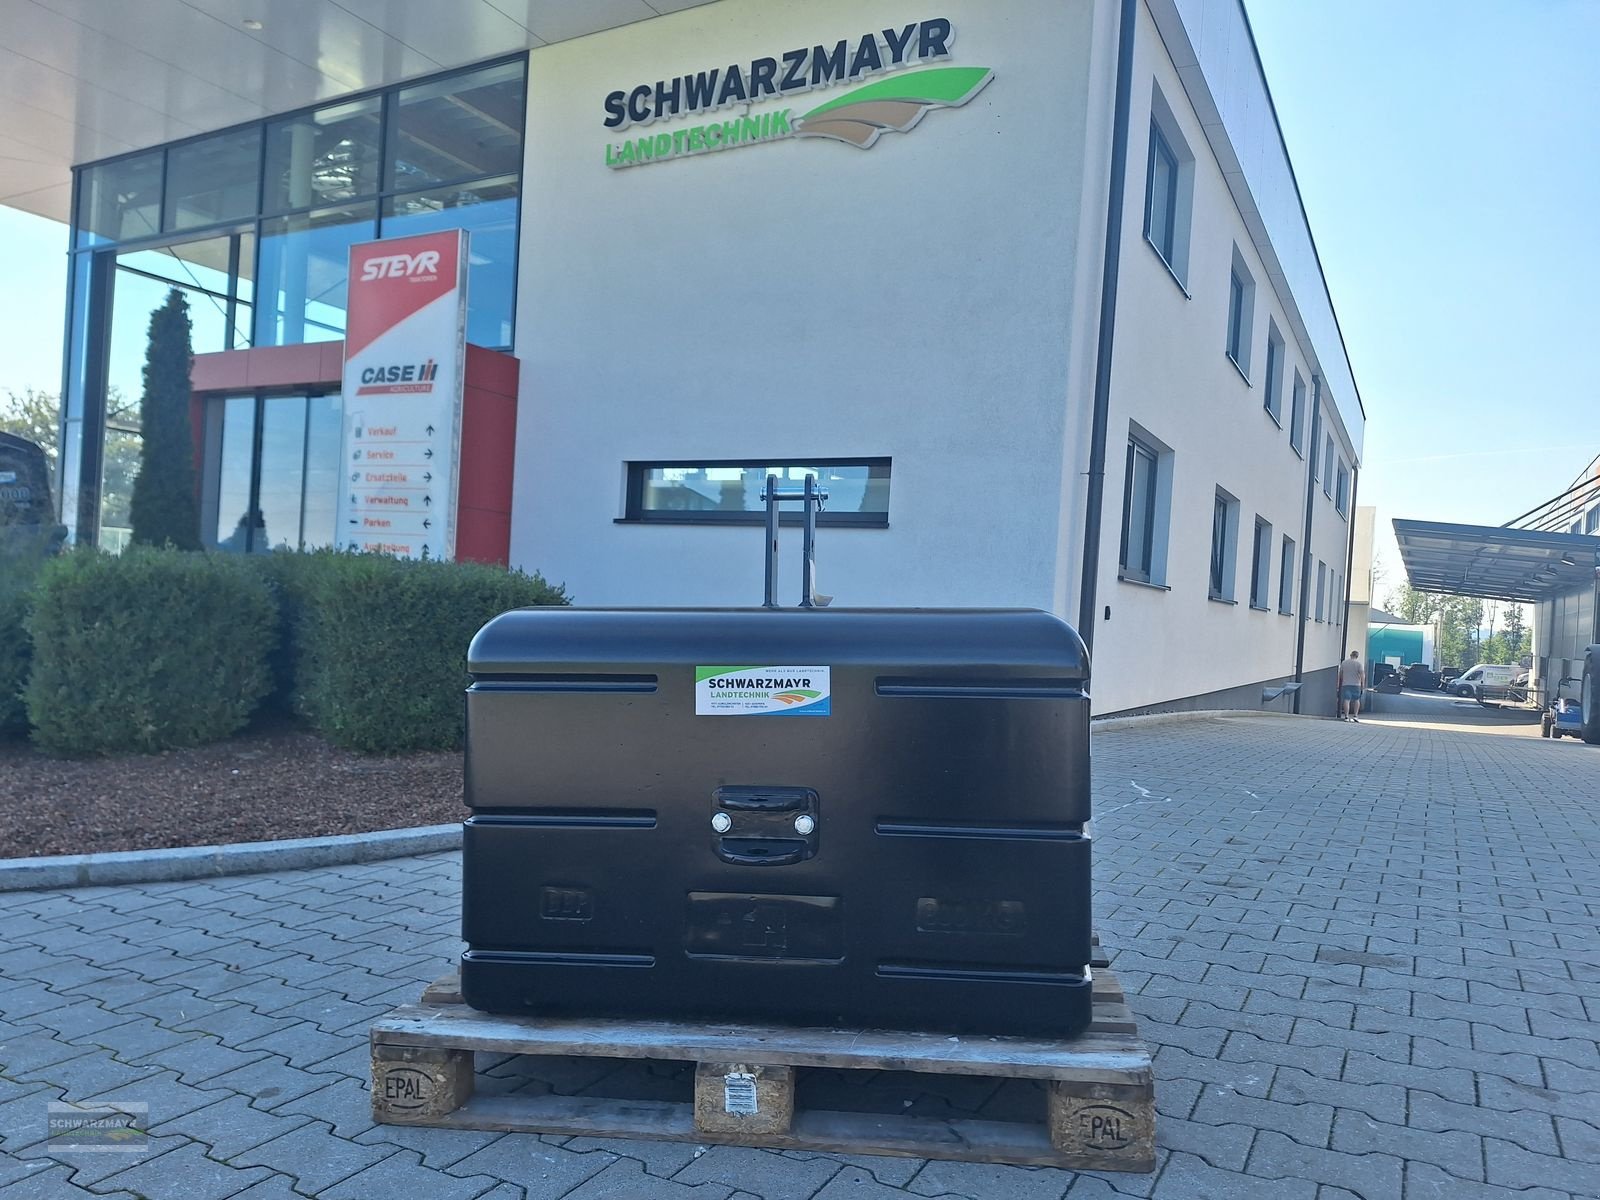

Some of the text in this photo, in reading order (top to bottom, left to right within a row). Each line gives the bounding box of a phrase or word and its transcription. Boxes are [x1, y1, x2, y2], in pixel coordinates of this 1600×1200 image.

[603, 17, 952, 128] SCHWARZMAYR
[606, 109, 791, 167] LANDTECHNIK
[360, 250, 440, 281] STEYR
[361, 365, 415, 384] CASE
[367, 426, 397, 436] Verkauf
[366, 450, 394, 459] Service
[365, 472, 407, 482] Ersatzteile
[364, 496, 409, 506] Verwaltung
[364, 518, 391, 527] Parken
[708, 678, 811, 689] SCHWARZMAYR
[710, 691, 770, 699] LANDTECHNIK
[385, 1077, 426, 1099] EPAL
[1080, 1113, 1128, 1141] EPAL
